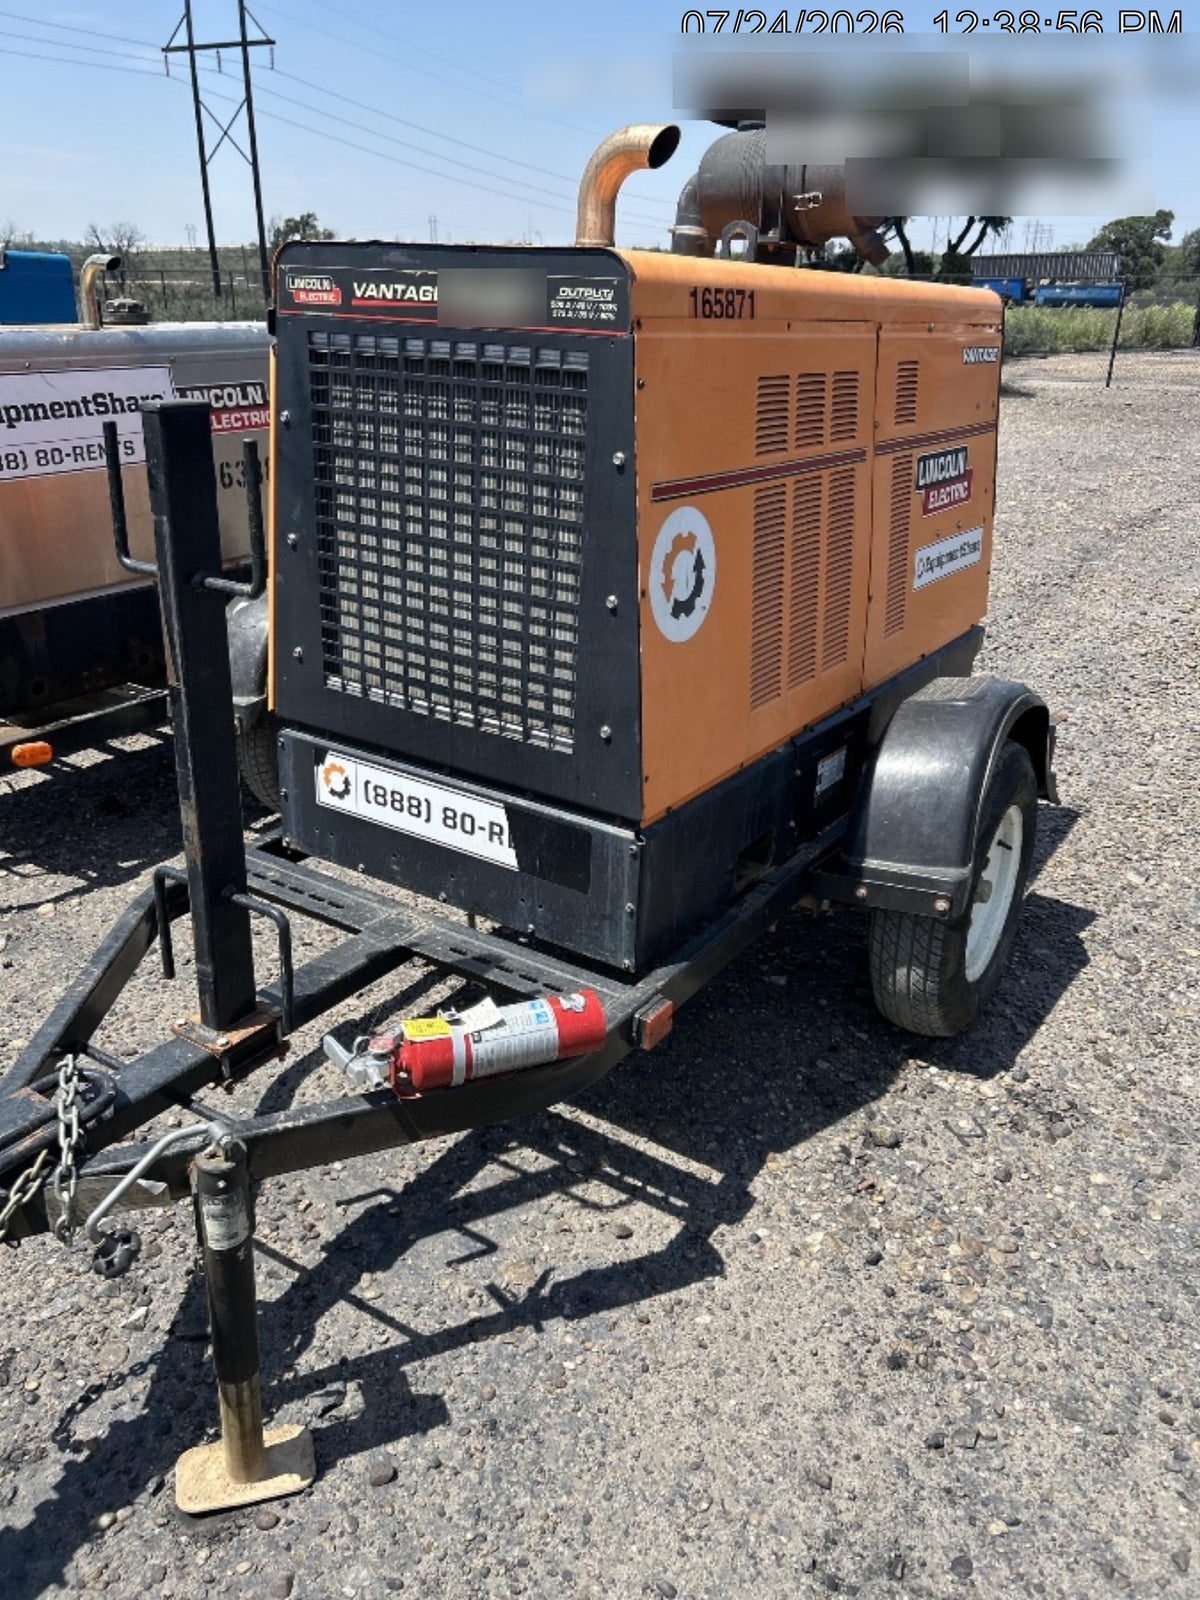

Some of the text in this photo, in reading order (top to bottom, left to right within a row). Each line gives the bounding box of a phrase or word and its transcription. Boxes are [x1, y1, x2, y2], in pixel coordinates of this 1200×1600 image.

[288, 276, 332, 290] LINCOLN
[353, 282, 438, 301] VANTAG
[559, 287, 612, 298] OUTPUT
[689, 286, 755, 319] 165871
[211, 410, 271, 429] LECTRI
[35, 440, 136, 467] 80-RENS
[918, 450, 967, 486] LINCOLN
[928, 481, 968, 509] ELECTRIC
[364, 780, 514, 848] (888) 80-R
